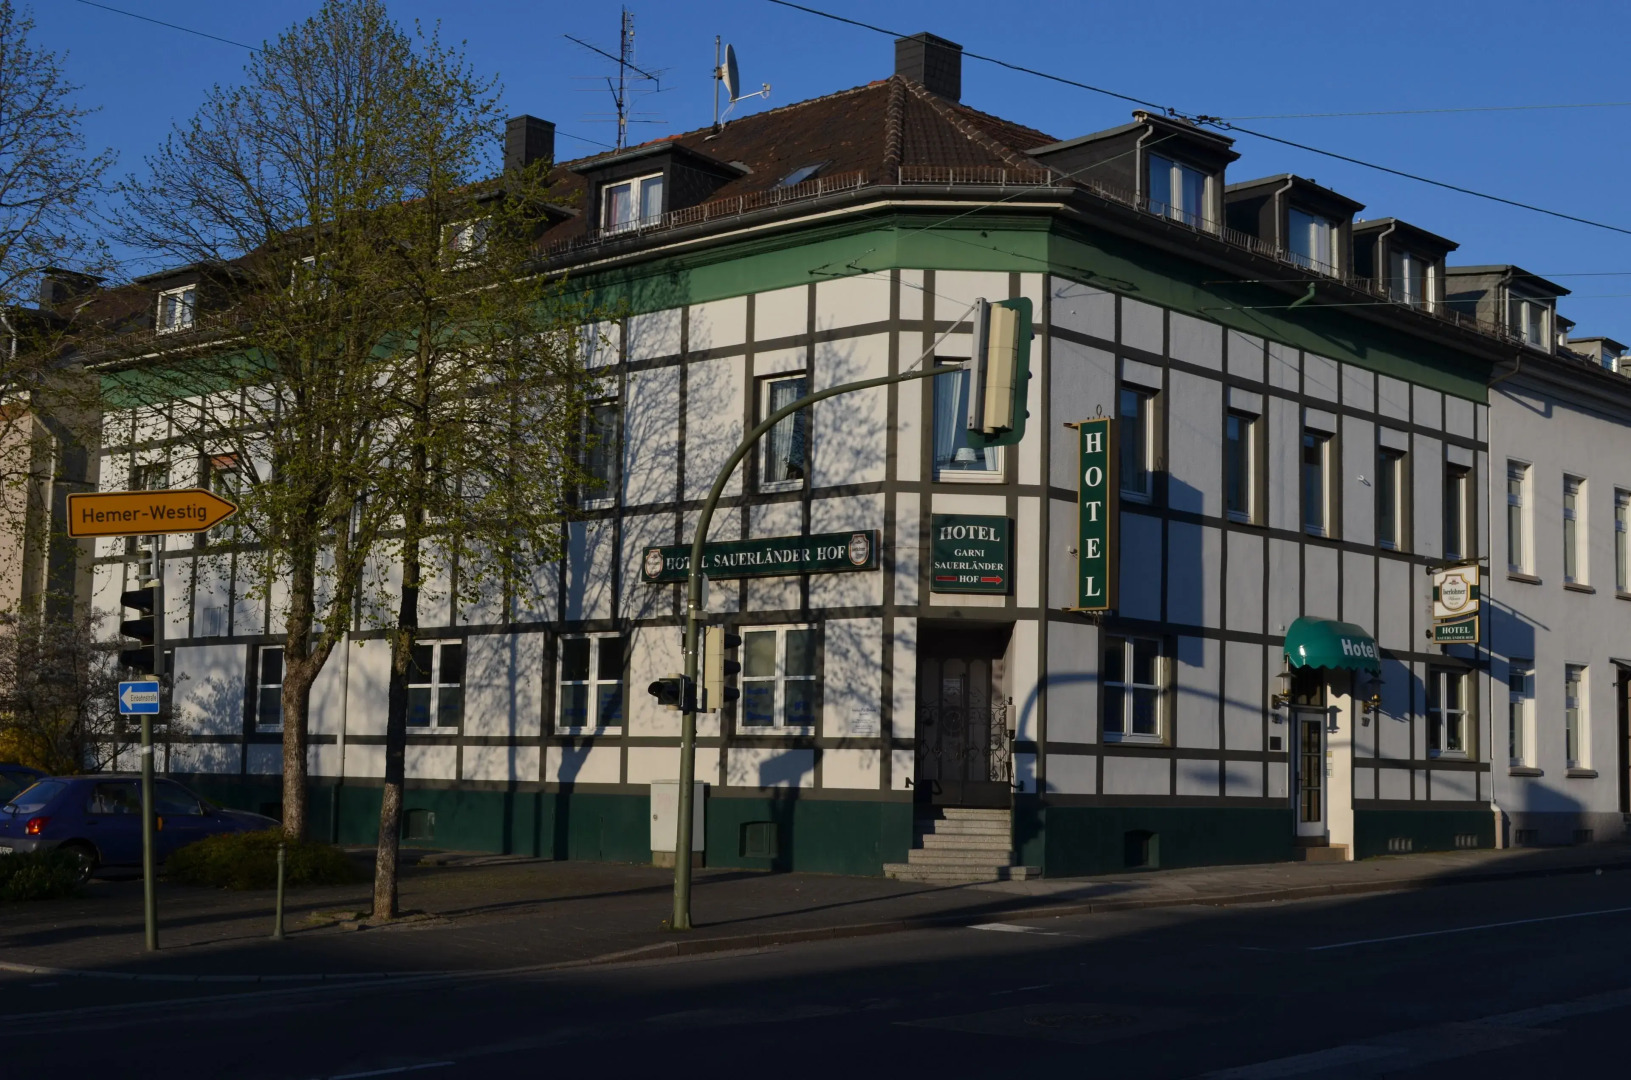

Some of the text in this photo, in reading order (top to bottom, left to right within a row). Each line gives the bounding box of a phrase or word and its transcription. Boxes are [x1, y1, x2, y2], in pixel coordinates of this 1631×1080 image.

[82, 503, 207, 523] Hemer-Westig
[1084, 432, 1103, 597] HOTEL
[939, 525, 1000, 542] HOTEL
[666, 545, 846, 570] HOTL SAUERLÄNDER HOF
[954, 548, 985, 557] GARNI
[934, 560, 1004, 571] SAUERLÄNDER
[959, 575, 979, 583] HOF
[1442, 626, 1470, 634] HOTEL
[1341, 638, 1377, 659] Hotel
